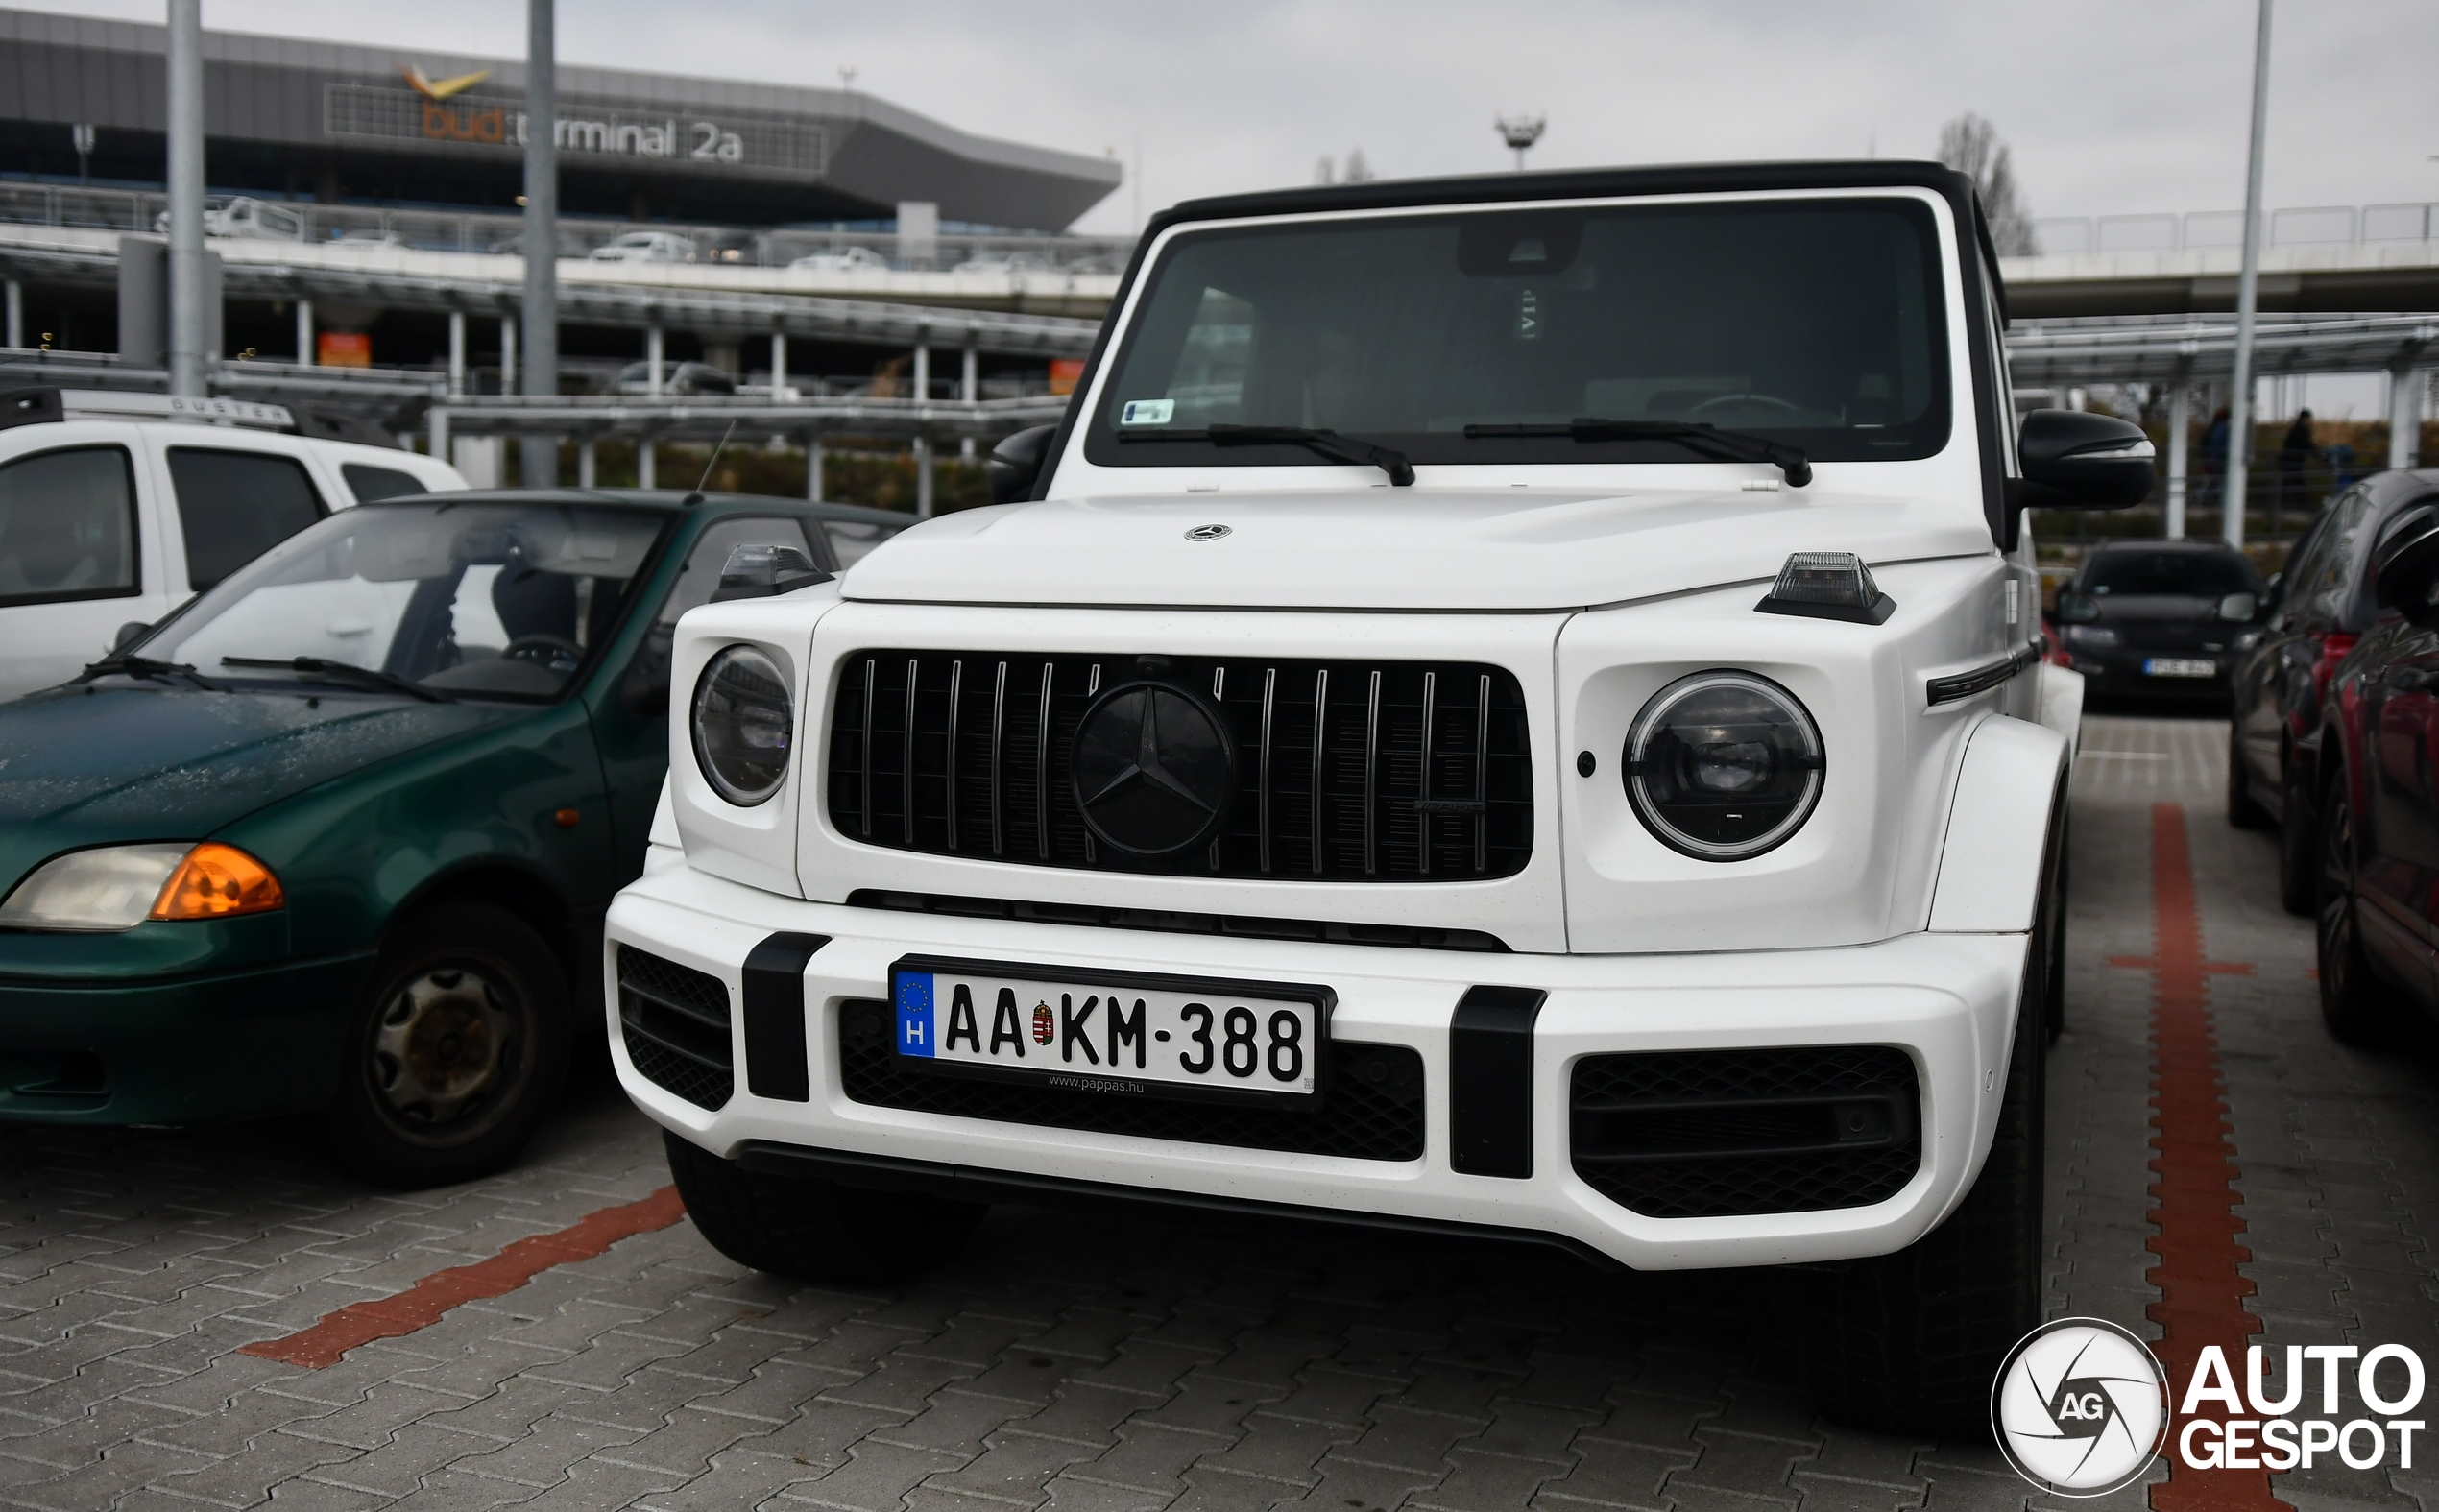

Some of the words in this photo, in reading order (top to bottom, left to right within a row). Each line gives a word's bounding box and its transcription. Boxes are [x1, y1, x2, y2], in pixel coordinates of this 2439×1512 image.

[690, 121, 744, 164] 2a
[906, 1020, 924, 1045] H
[945, 983, 1026, 1058] AA
[1061, 992, 1304, 1083] KM-388
[1049, 1074, 1145, 1094] www.pappas.hu
